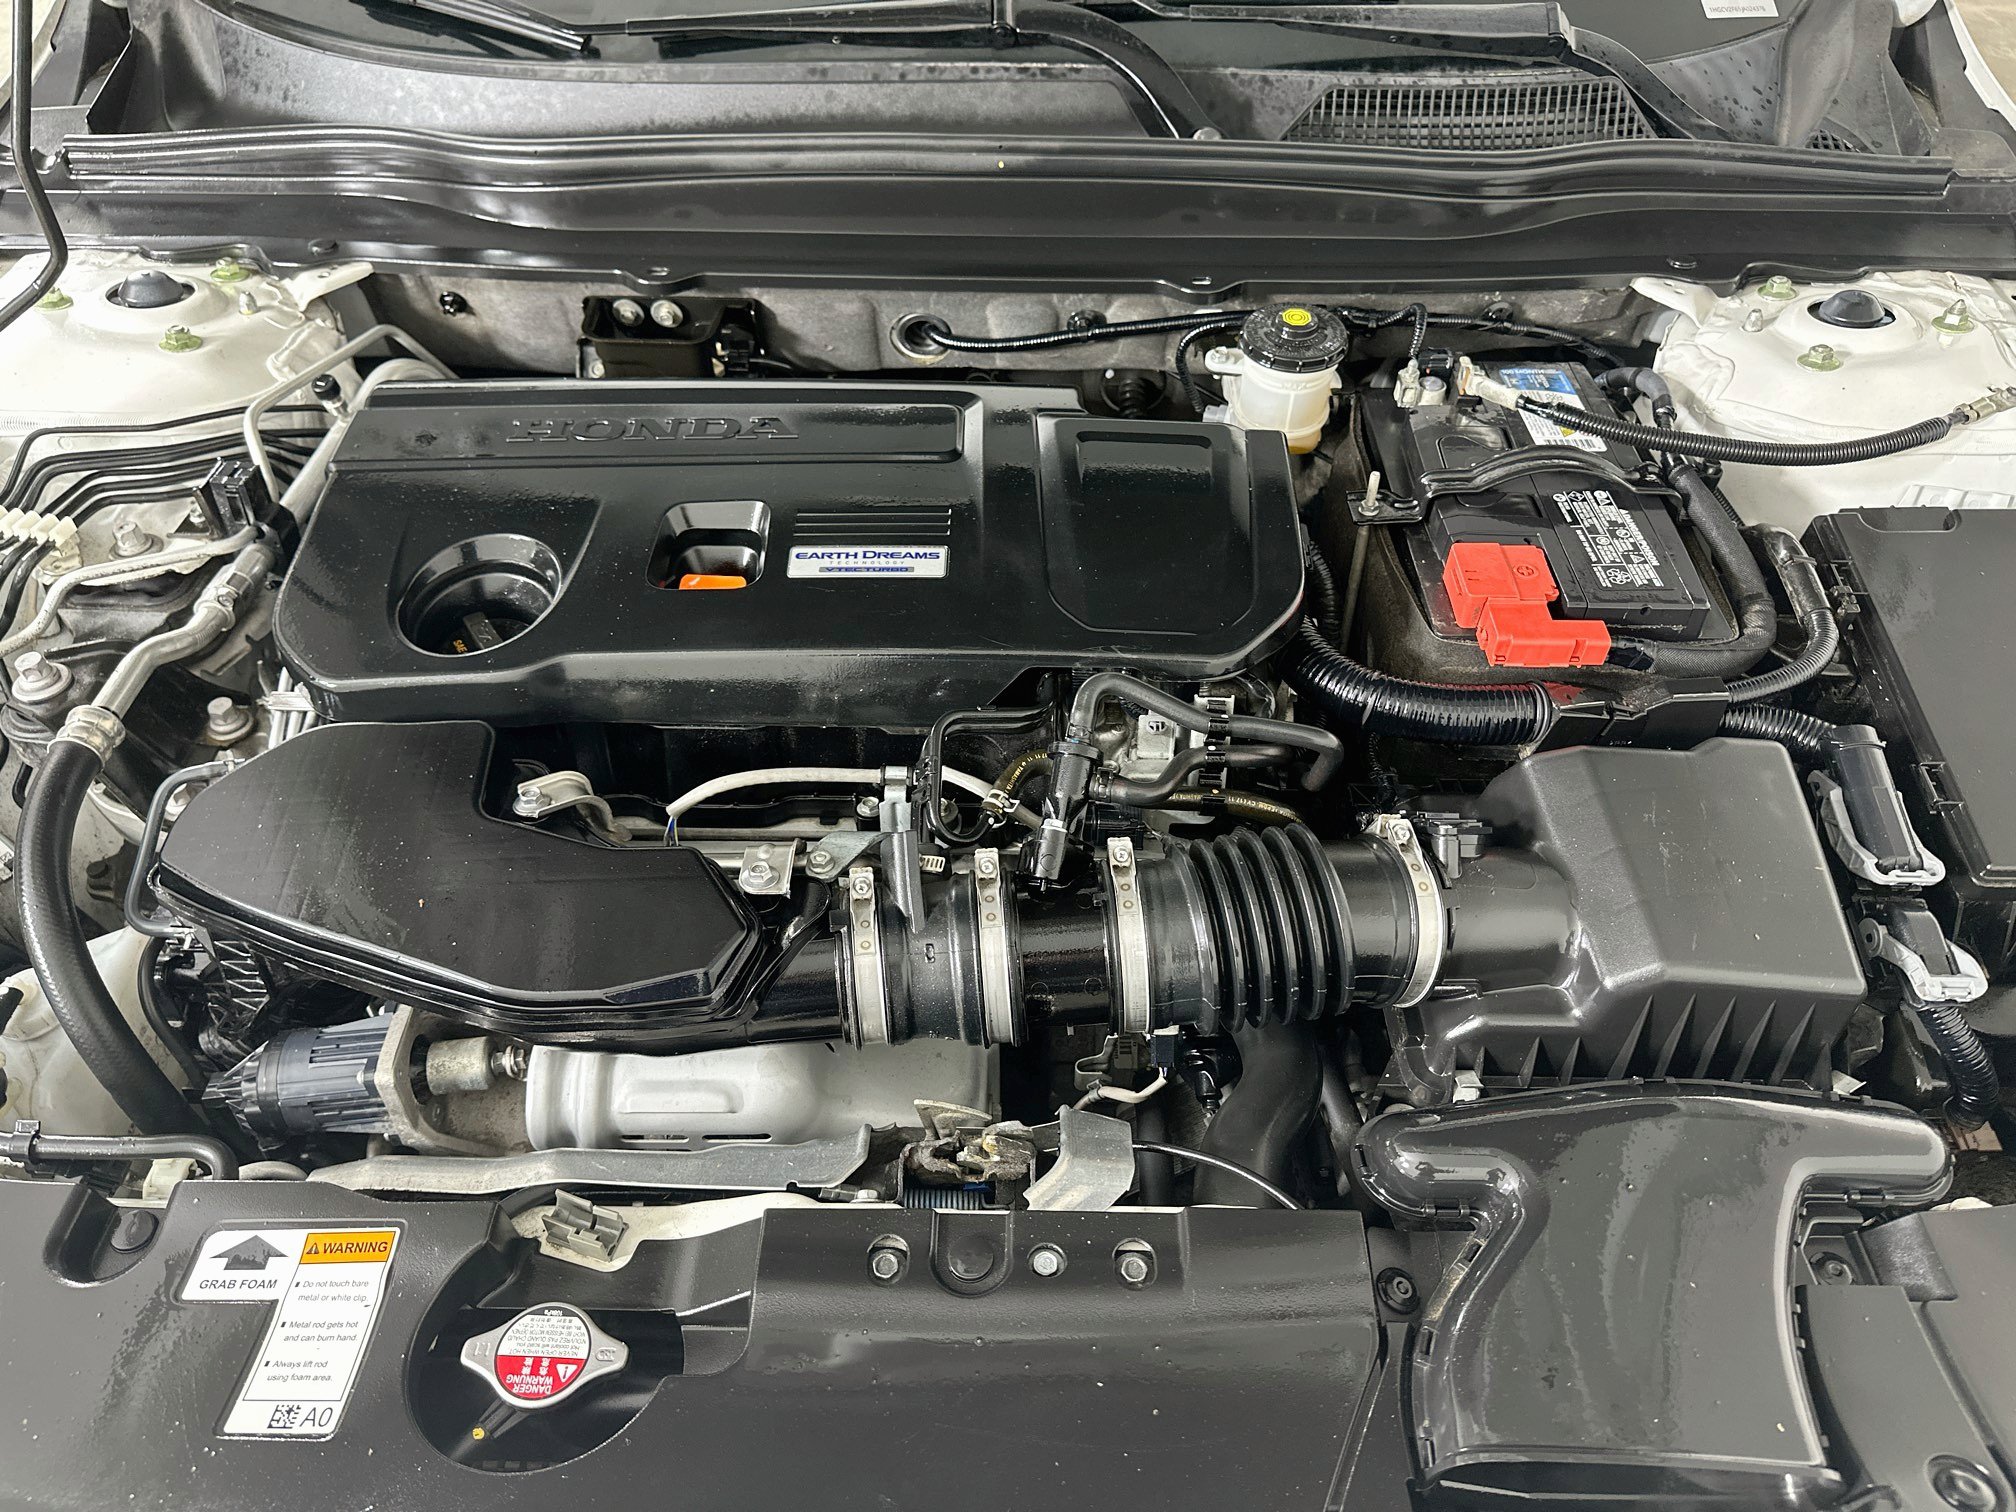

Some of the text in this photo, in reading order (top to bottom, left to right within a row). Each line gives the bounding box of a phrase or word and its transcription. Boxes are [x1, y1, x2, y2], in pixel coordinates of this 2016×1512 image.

[506, 417, 799, 442] HONDA
[795, 550, 941, 560] EARTH DREAMS
[322, 1241, 388, 1254] WARNING
[199, 1279, 278, 1290] GRAB FOAM
[316, 1280, 328, 1288] not
[297, 1293, 320, 1301] metal
[331, 1293, 351, 1301] white
[327, 1322, 343, 1330] gets
[316, 1334, 336, 1342] burn
[337, 1334, 358, 1342] hand.
[272, 1360, 328, 1369] Always lift rod
[266, 1374, 288, 1382] using
[506, 1374, 554, 1385] WARNUNG
[512, 1383, 552, 1395] DANGER
[300, 1407, 334, 1427] A0
